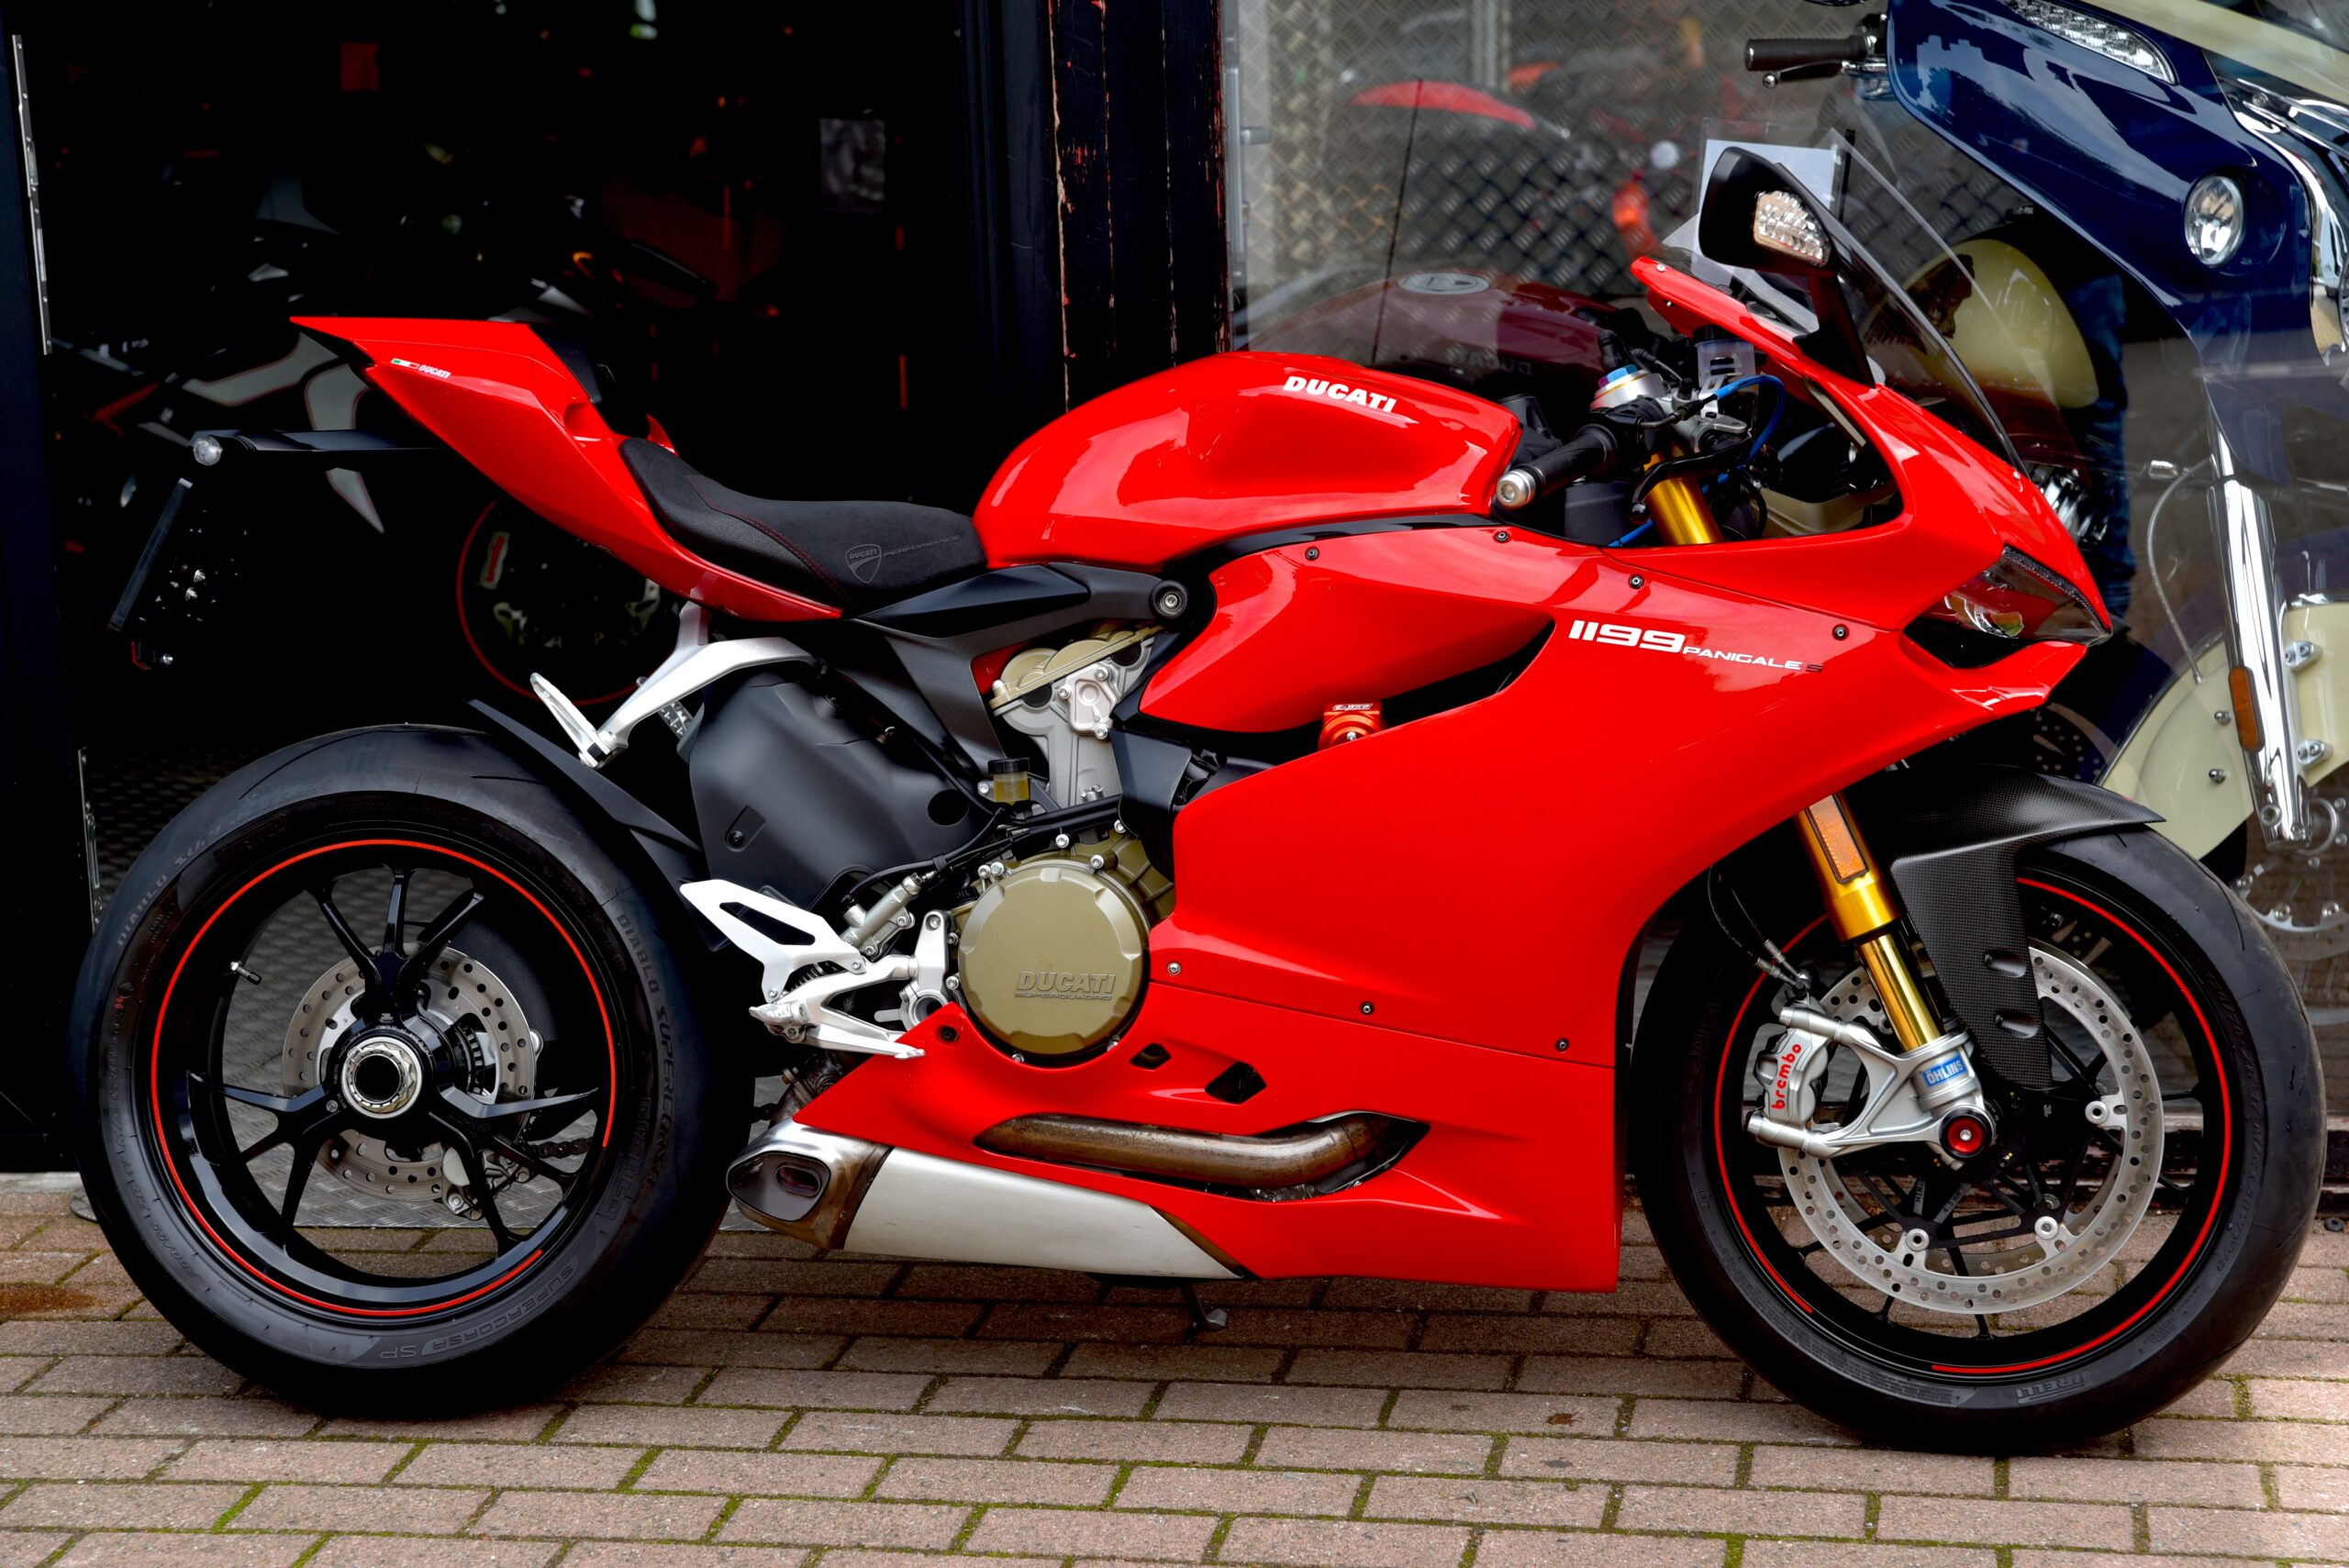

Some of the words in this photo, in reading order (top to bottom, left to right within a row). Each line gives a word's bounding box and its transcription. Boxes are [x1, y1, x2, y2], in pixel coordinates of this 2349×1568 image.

[418, 364, 451, 379] DUCATI
[1282, 375, 1397, 413] DUCATI
[849, 548, 878, 560] DUCATI
[1568, 619, 1686, 653] 1199
[1682, 646, 1803, 671] PANIGALE
[1805, 662, 1824, 673] S
[616, 912, 659, 994] DIABLO
[1014, 991, 1112, 1000] SUPERQUADRO
[1016, 971, 1117, 994] DUCATI
[1771, 1043, 1802, 1110] brembo
[1927, 1059, 1965, 1086] ÖHLINS
[431, 1264, 574, 1350] SUPERCORSA
[380, 1343, 417, 1360] SP
